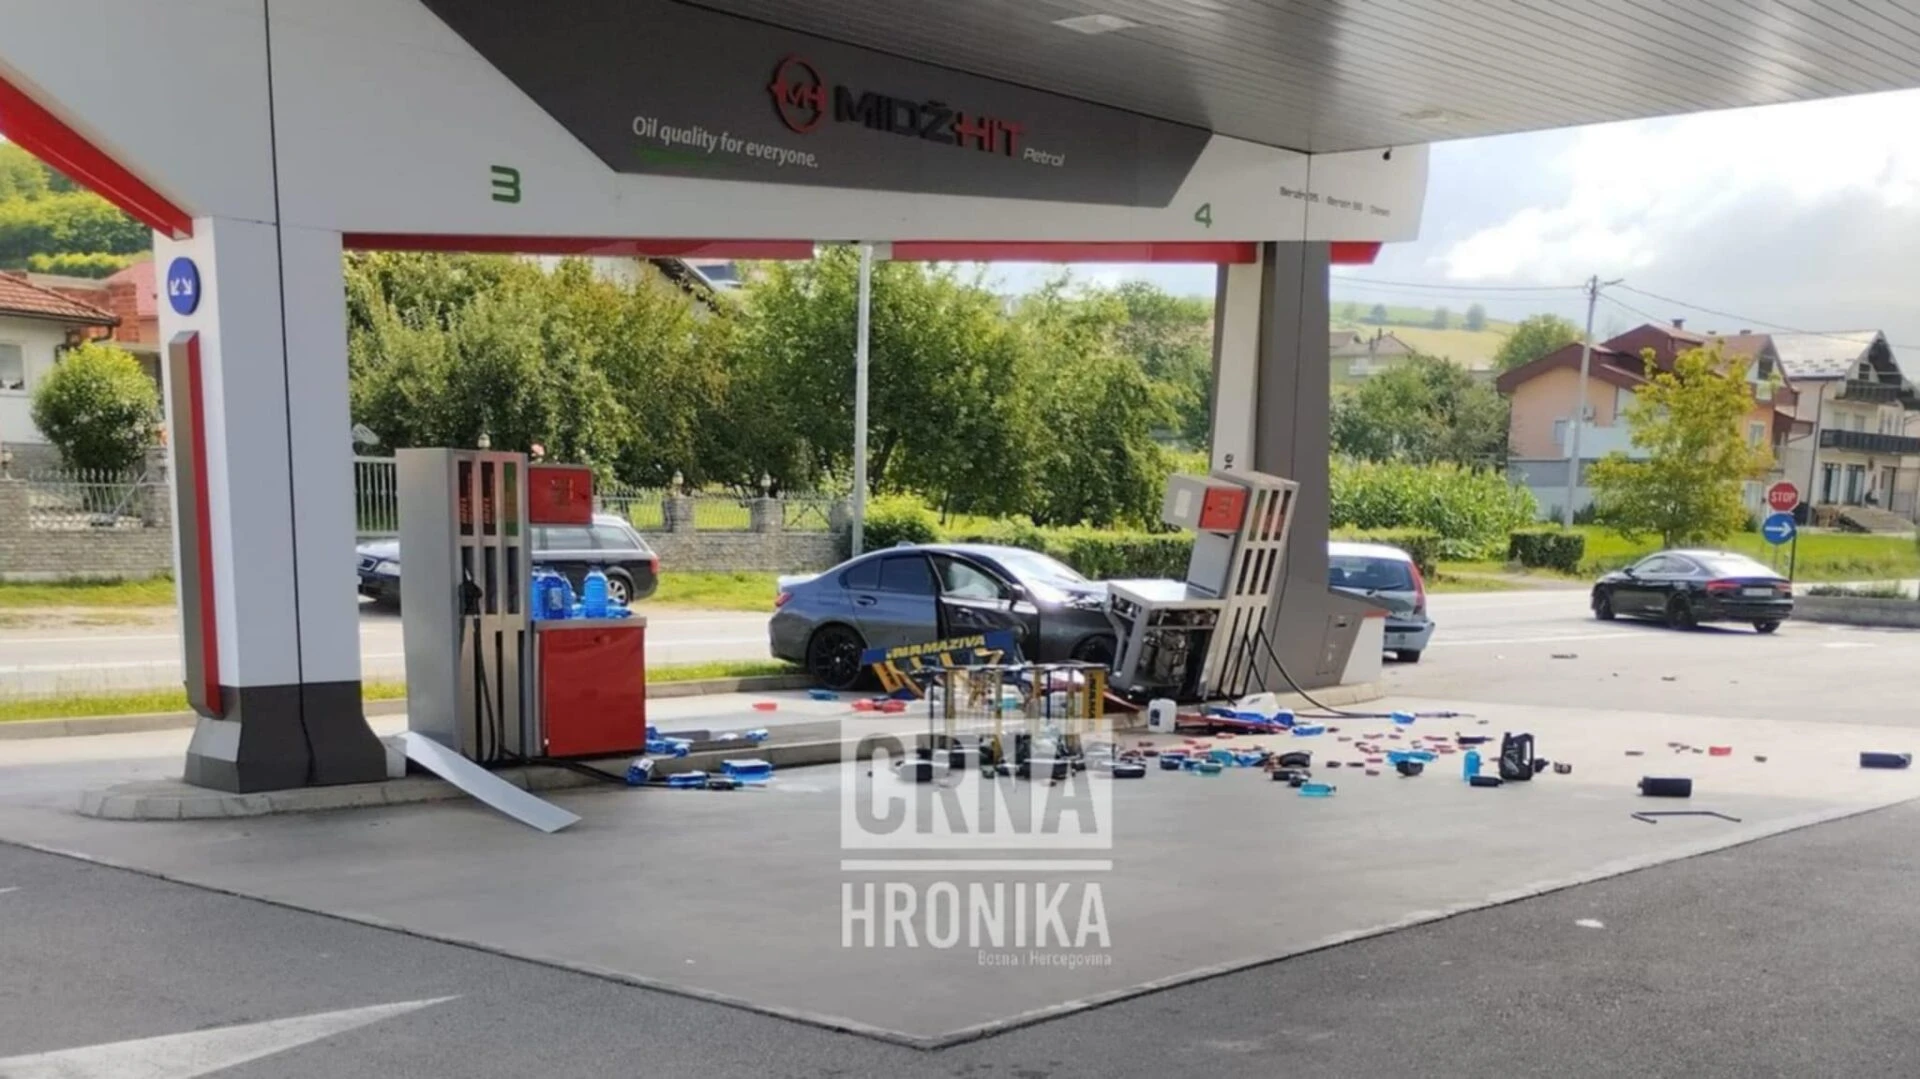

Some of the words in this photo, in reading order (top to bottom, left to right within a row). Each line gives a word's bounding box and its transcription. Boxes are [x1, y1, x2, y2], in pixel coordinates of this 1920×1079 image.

[632, 116, 658, 138] Oil
[660, 125, 718, 154] quality
[720, 132, 744, 155] for
[746, 141, 819, 169] everyone.
[1023, 147, 1066, 167] Petrol
[490, 164, 521, 204] 3
[1194, 202, 1213, 229] 4
[1771, 491, 1797, 503] STOP
[922, 635, 985, 654] MAZIVA
